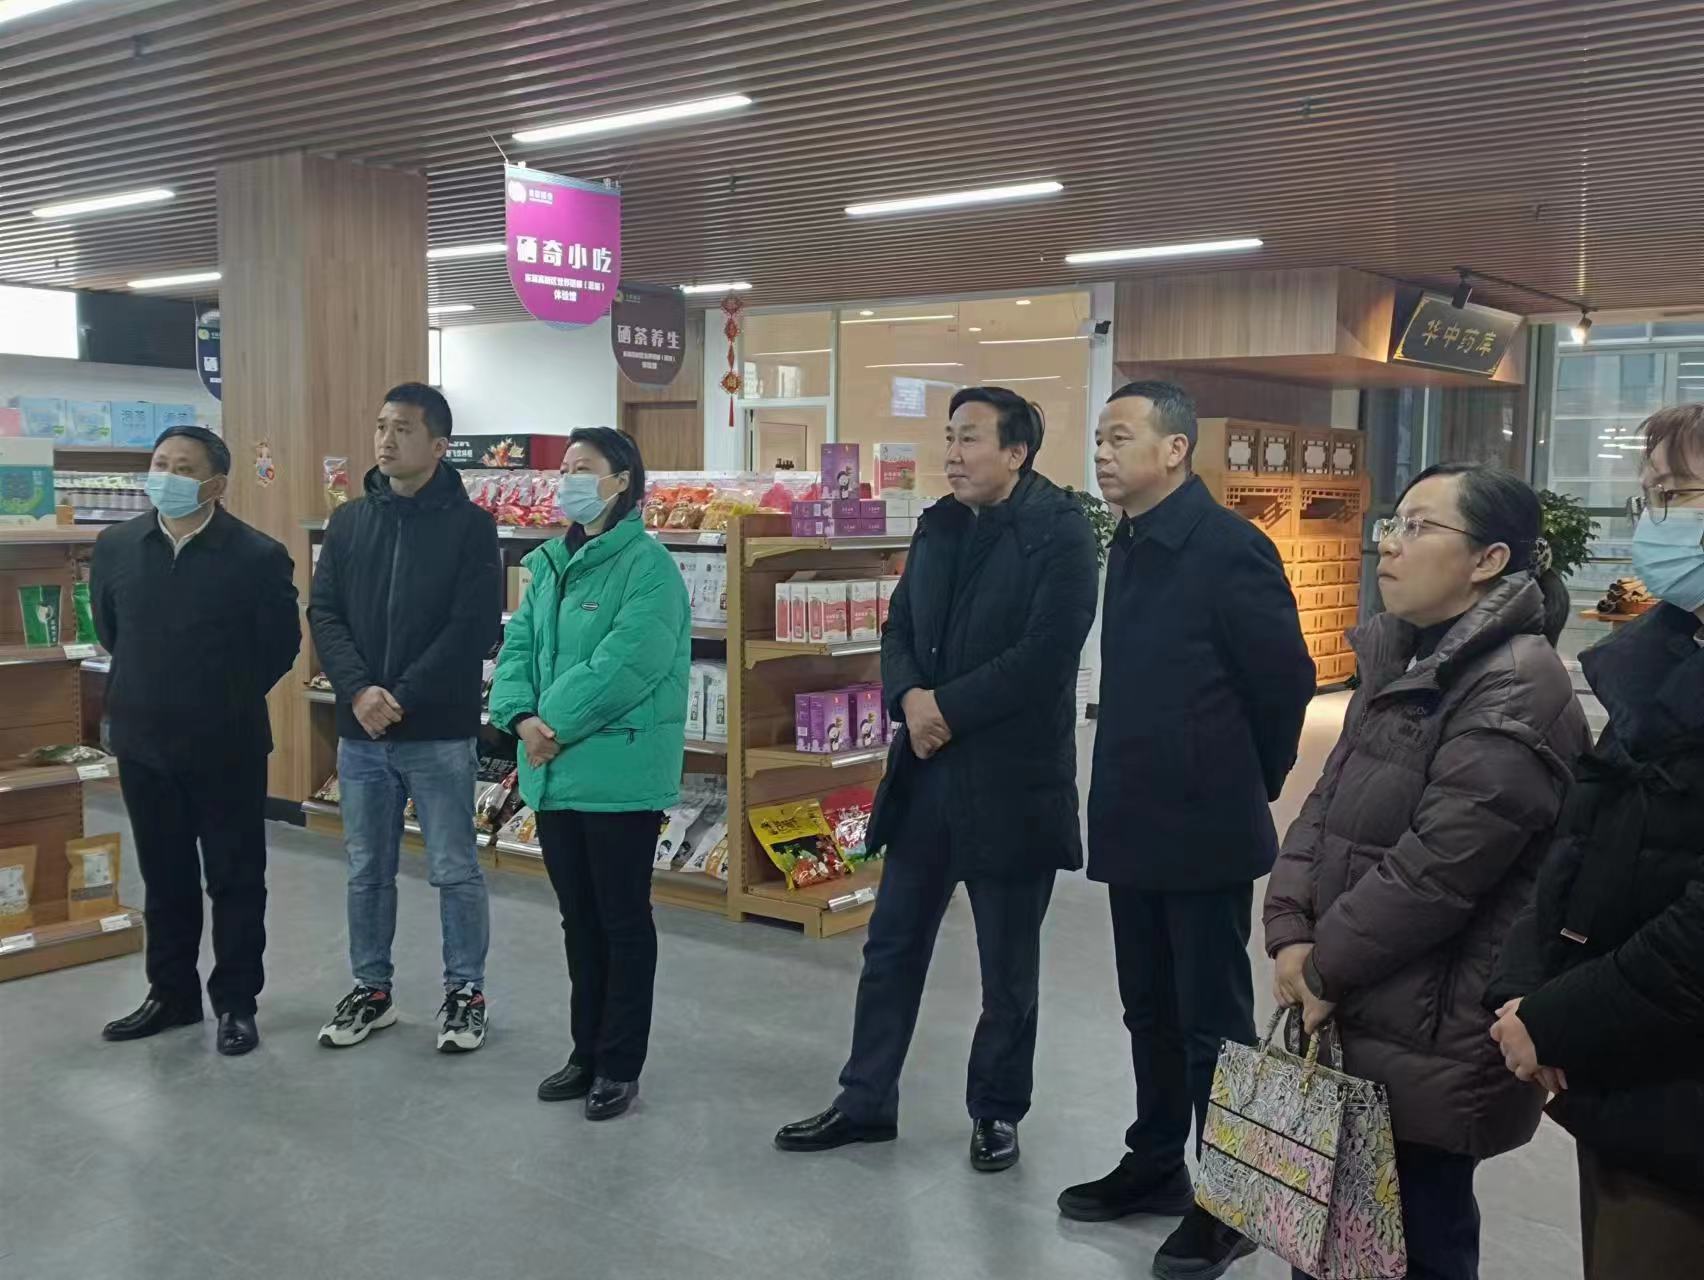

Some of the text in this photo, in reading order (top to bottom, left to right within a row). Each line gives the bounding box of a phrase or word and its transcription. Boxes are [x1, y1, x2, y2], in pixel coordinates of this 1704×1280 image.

[517, 236, 611, 273] 硒奇小吃
[617, 325, 680, 349] 硒茶养生
